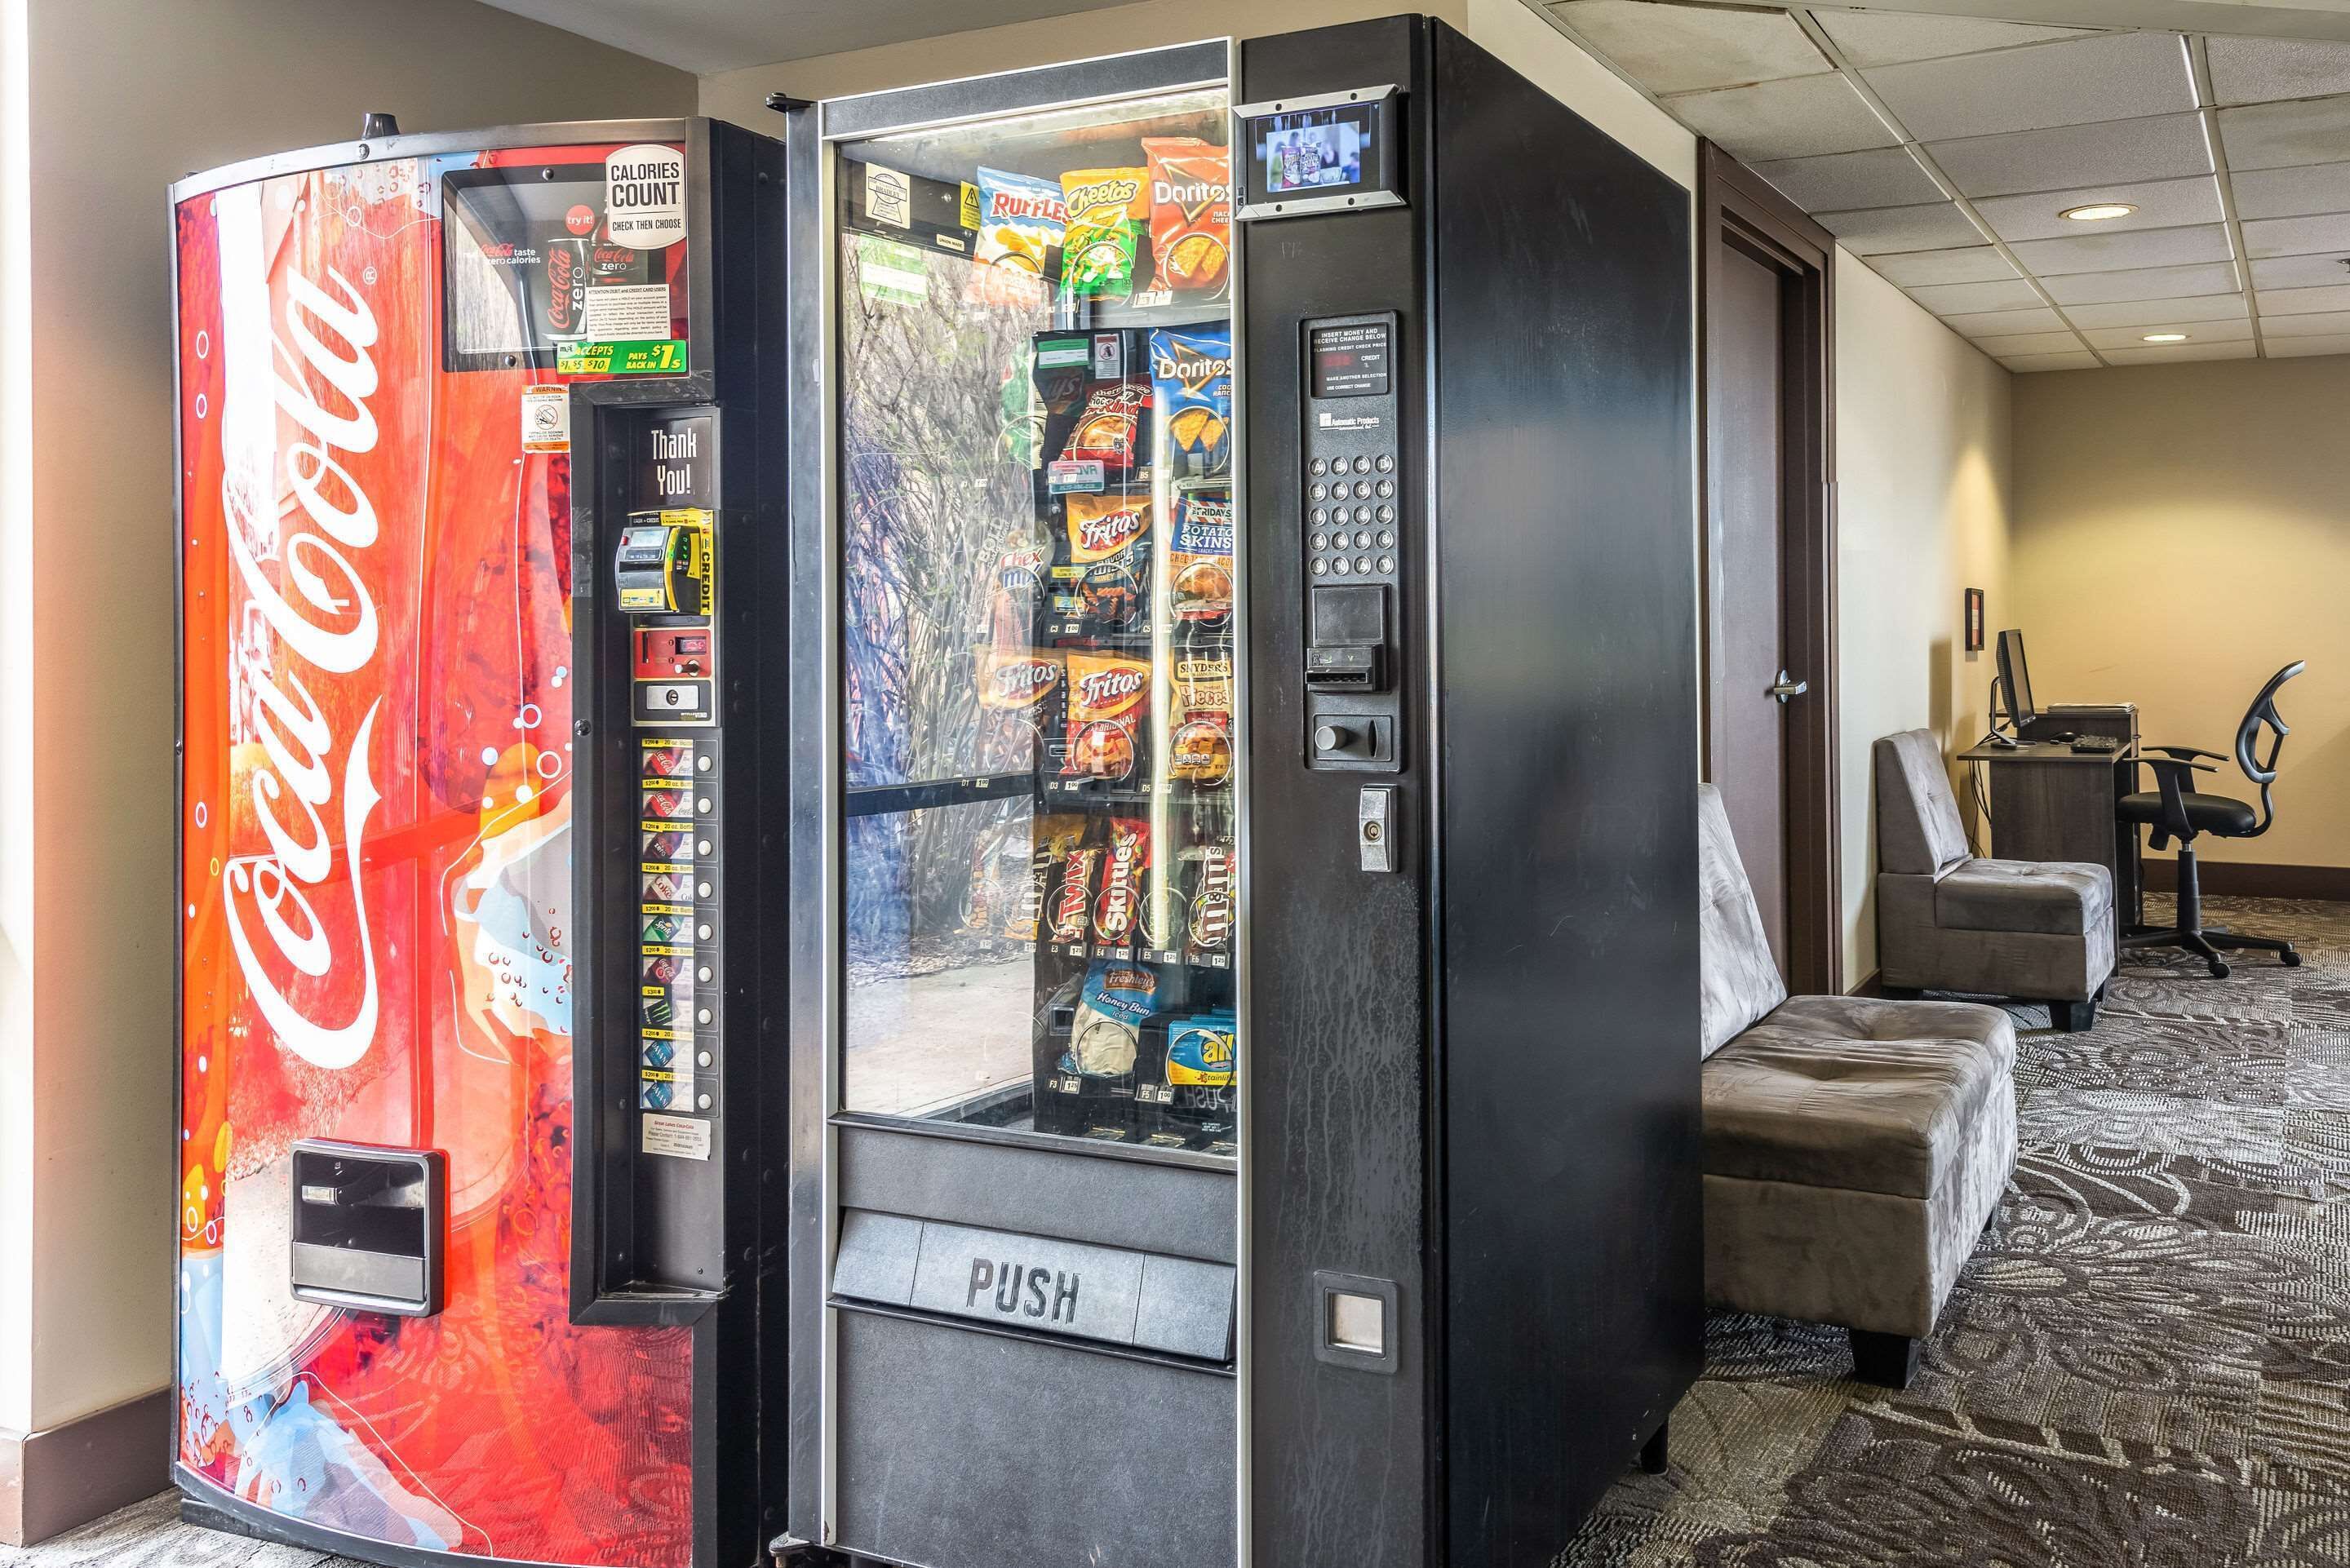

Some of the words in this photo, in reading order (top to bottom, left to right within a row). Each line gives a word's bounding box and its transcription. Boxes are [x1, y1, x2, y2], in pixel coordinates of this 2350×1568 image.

[611, 162, 680, 181] CALORIES
[612, 182, 680, 207] COUNT
[1067, 182, 1136, 217] Cheetos
[1154, 181, 1230, 204] Doritos
[992, 193, 1071, 224] RUFFLES
[567, 215, 581, 226] try
[582, 215, 593, 224] it!
[613, 222, 634, 231] CHECK
[636, 220, 653, 229] THEN
[655, 219, 681, 228] CHOOSE
[507, 256, 541, 264] calories
[601, 261, 627, 271] zero
[572, 267, 584, 311] zero
[574, 346, 614, 356] ACCEPTS
[1159, 359, 1232, 379] Doritos
[1332, 417, 1356, 425] Automatic
[1357, 417, 1380, 425] Products
[651, 427, 697, 460] Thank
[657, 463, 691, 496] You!
[1197, 507, 1231, 517] FRIDAYS
[1079, 509, 1140, 551] Fritos
[1182, 523, 1233, 537] POTATO
[1180, 534, 1232, 548] SKINS
[1000, 547, 1044, 569] Chex
[702, 551, 712, 611] CREDIT
[222, 266, 381, 1071] Coca-Cola
[995, 662, 1058, 697] Fritos
[1080, 669, 1144, 706] Fritos
[1179, 685, 1230, 706] Pieces
[1142, 784, 1151, 792] D5
[654, 843, 666, 857] zero
[654, 876, 672, 899] Coke
[1058, 849, 1086, 925] TWIX
[1105, 832, 1137, 932] Skittles
[655, 920, 672, 939] Sprite
[1097, 948, 1104, 956] E4
[1143, 951, 1151, 960] E5
[1110, 972, 1155, 990] Freshley's
[1097, 992, 1128, 1011] Honey
[1128, 1002, 1150, 1016] Bun
[1112, 1011, 1129, 1020] Iced
[1202, 1034, 1235, 1064] all
[966, 1257, 1081, 1324] PUSH
